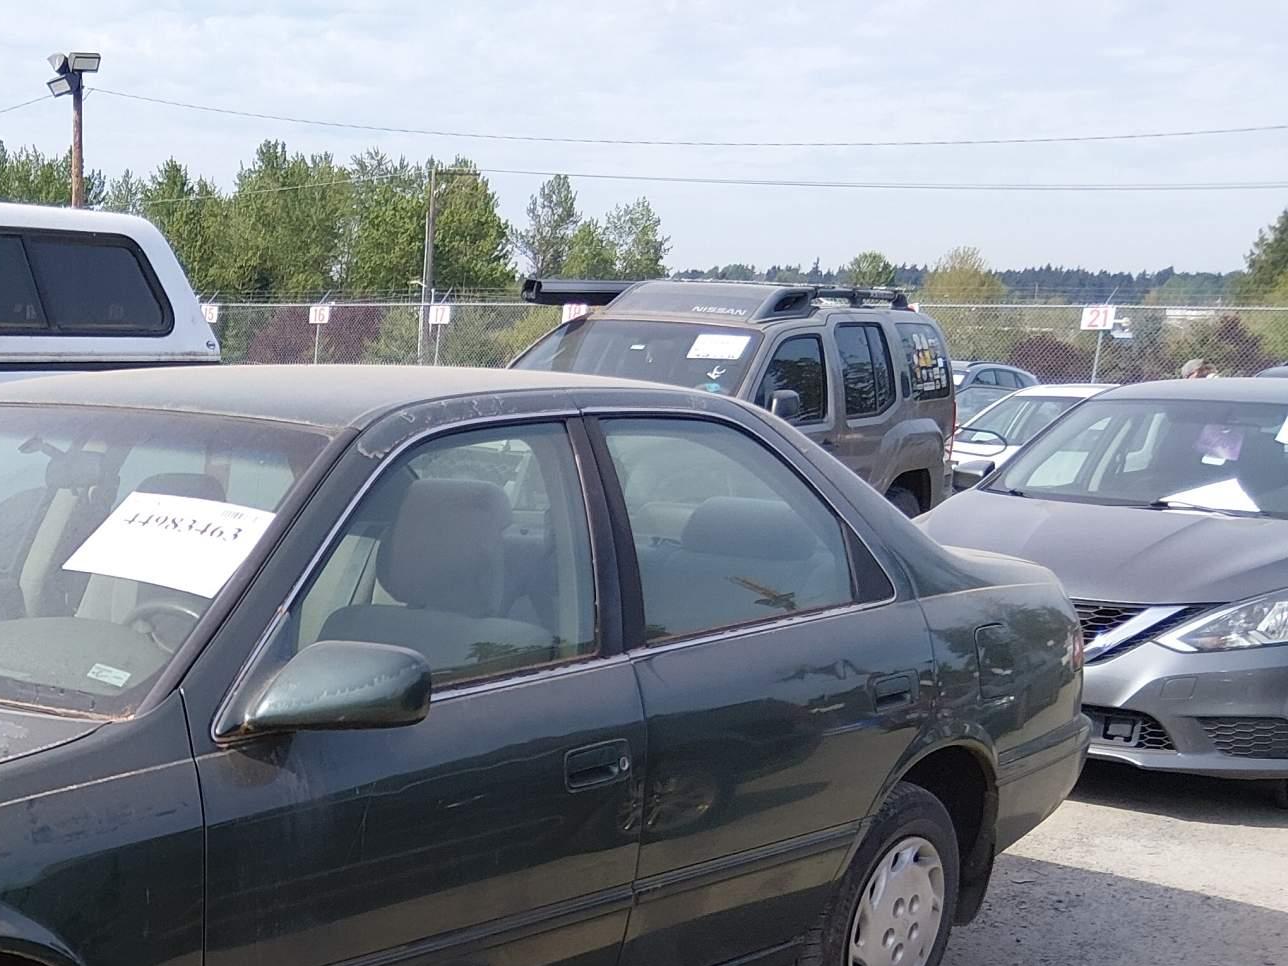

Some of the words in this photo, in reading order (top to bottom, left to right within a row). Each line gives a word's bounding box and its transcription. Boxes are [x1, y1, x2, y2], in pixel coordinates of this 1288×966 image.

[314, 307, 325, 321] 16
[435, 307, 446, 322] 17
[692, 306, 747, 315] NISSAN
[1087, 309, 1109, 328] 21
[124, 513, 242, 541] 44983463
